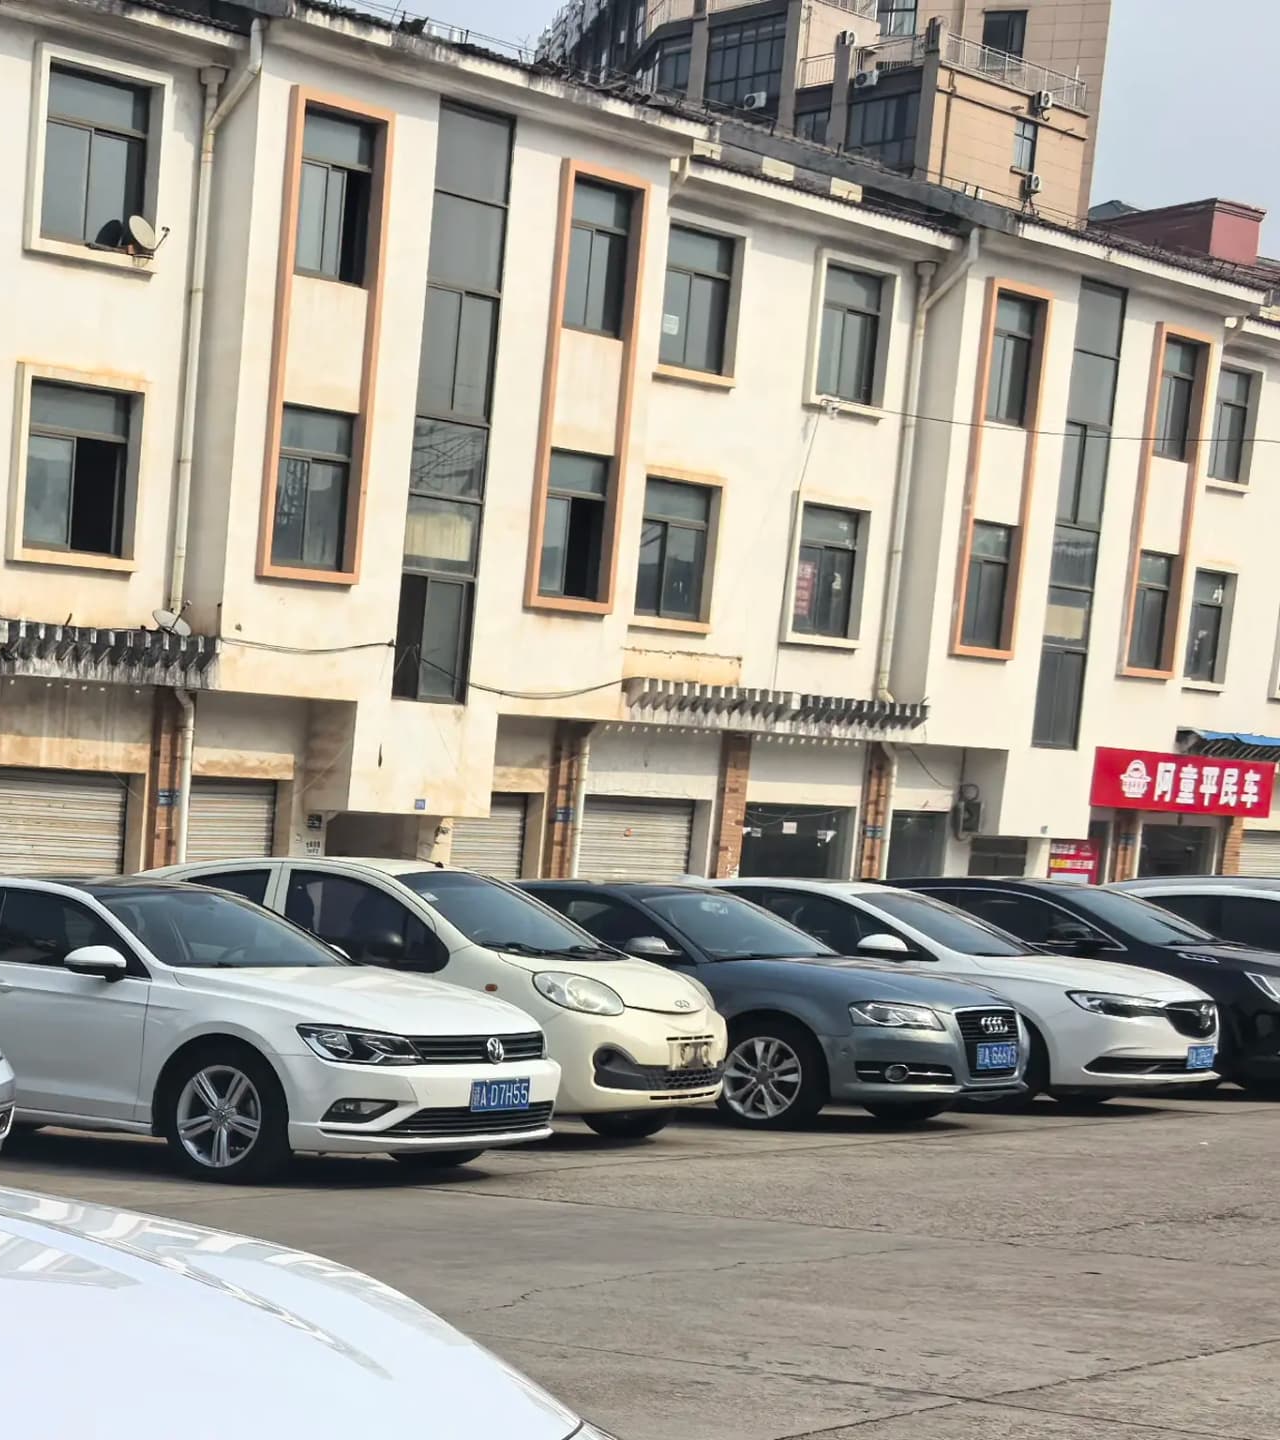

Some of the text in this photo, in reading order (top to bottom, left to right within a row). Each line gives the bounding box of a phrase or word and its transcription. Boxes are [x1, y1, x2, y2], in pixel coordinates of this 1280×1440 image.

[1153, 762, 1261, 809] 阿童平民车
